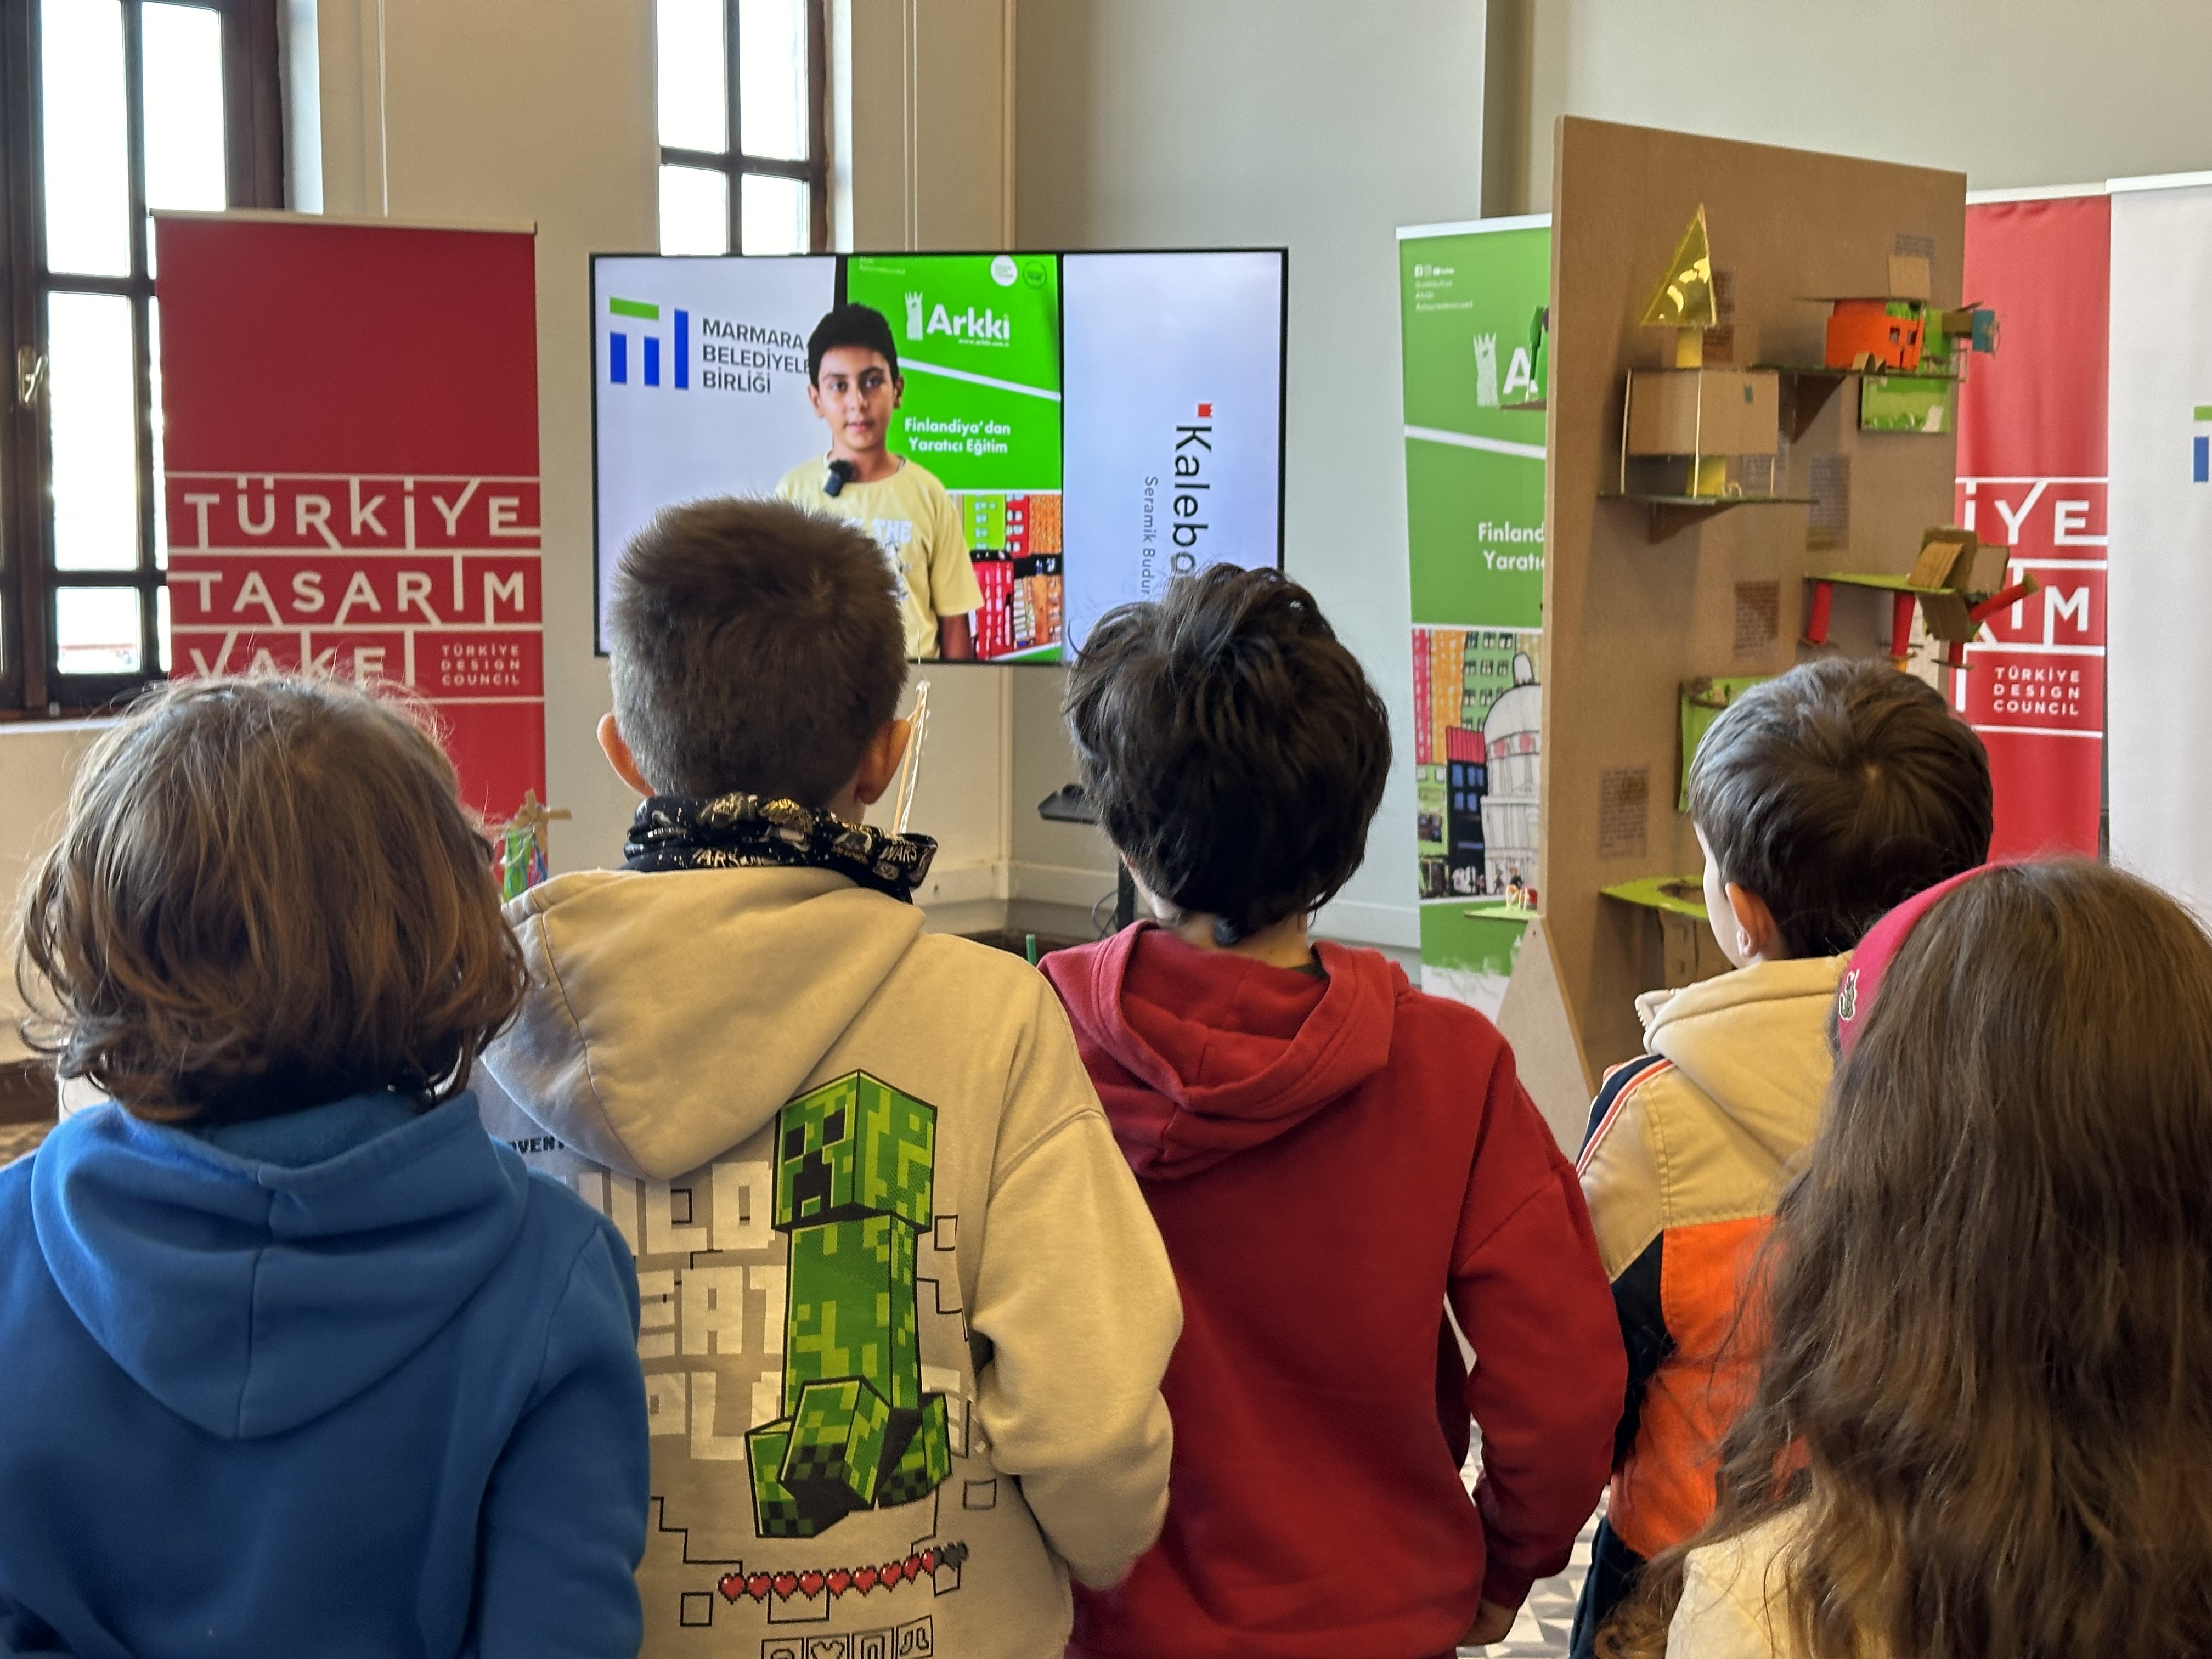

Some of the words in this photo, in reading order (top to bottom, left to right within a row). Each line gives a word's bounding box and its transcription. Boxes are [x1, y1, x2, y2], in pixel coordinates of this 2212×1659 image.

[927, 303, 1010, 340] Arkki
[703, 317, 804, 351] MARMARA
[703, 366, 770, 394] BİRLİĞİ
[909, 436, 963, 452] Yaratıcı
[966, 438, 1008, 456] Eğitim
[184, 477, 540, 549] TÜRKİYE
[1143, 476, 1158, 542] Seramik
[167, 555, 524, 625] TASARIM
[441, 658, 520, 672] DESIGN
[1995, 665, 2080, 683] TÜRKİYE
[442, 673, 520, 686] COUNCIL
[1993, 684, 2080, 699] DESIGN
[1993, 699, 2079, 716] COUNCIL
